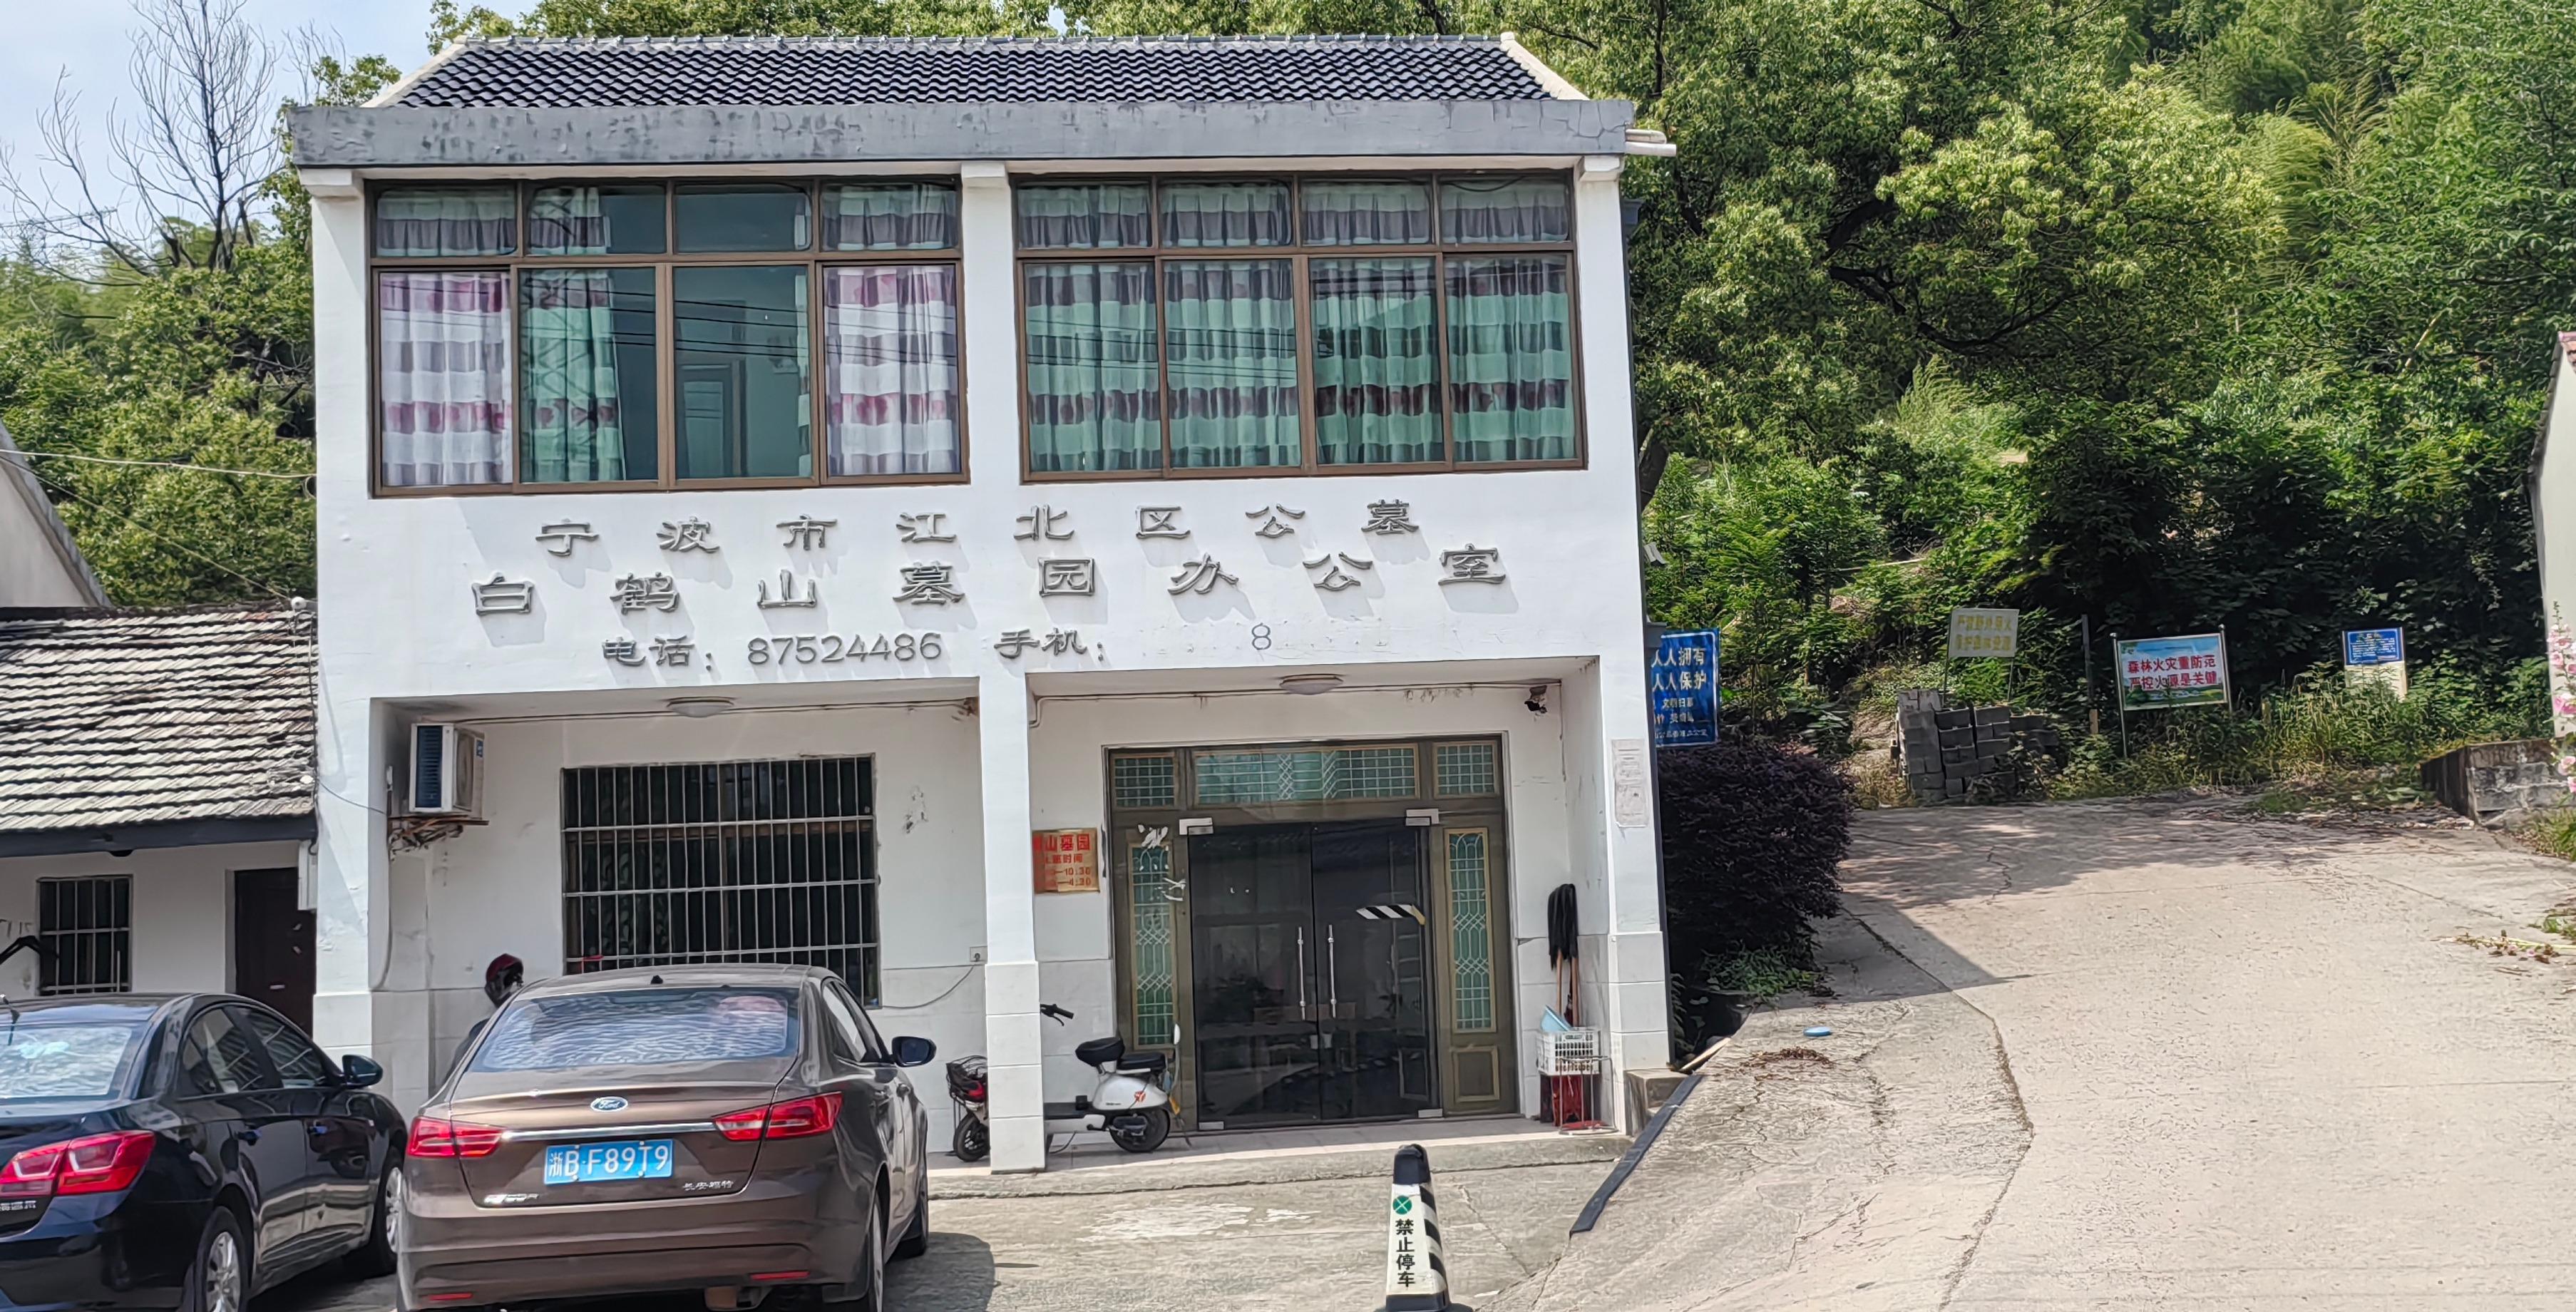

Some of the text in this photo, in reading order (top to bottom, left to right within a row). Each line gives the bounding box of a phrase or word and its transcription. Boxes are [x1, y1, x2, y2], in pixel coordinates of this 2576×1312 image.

[536, 498, 1420, 557] 宁波市江北区公墓
[471, 543, 1507, 616] 白鹤山墓园办公室
[1652, 670, 1708, 692] 人人保护
[2127, 655, 2217, 674] 森林火灾重防范
[1395, 1218, 1416, 1288] 禁止停车
